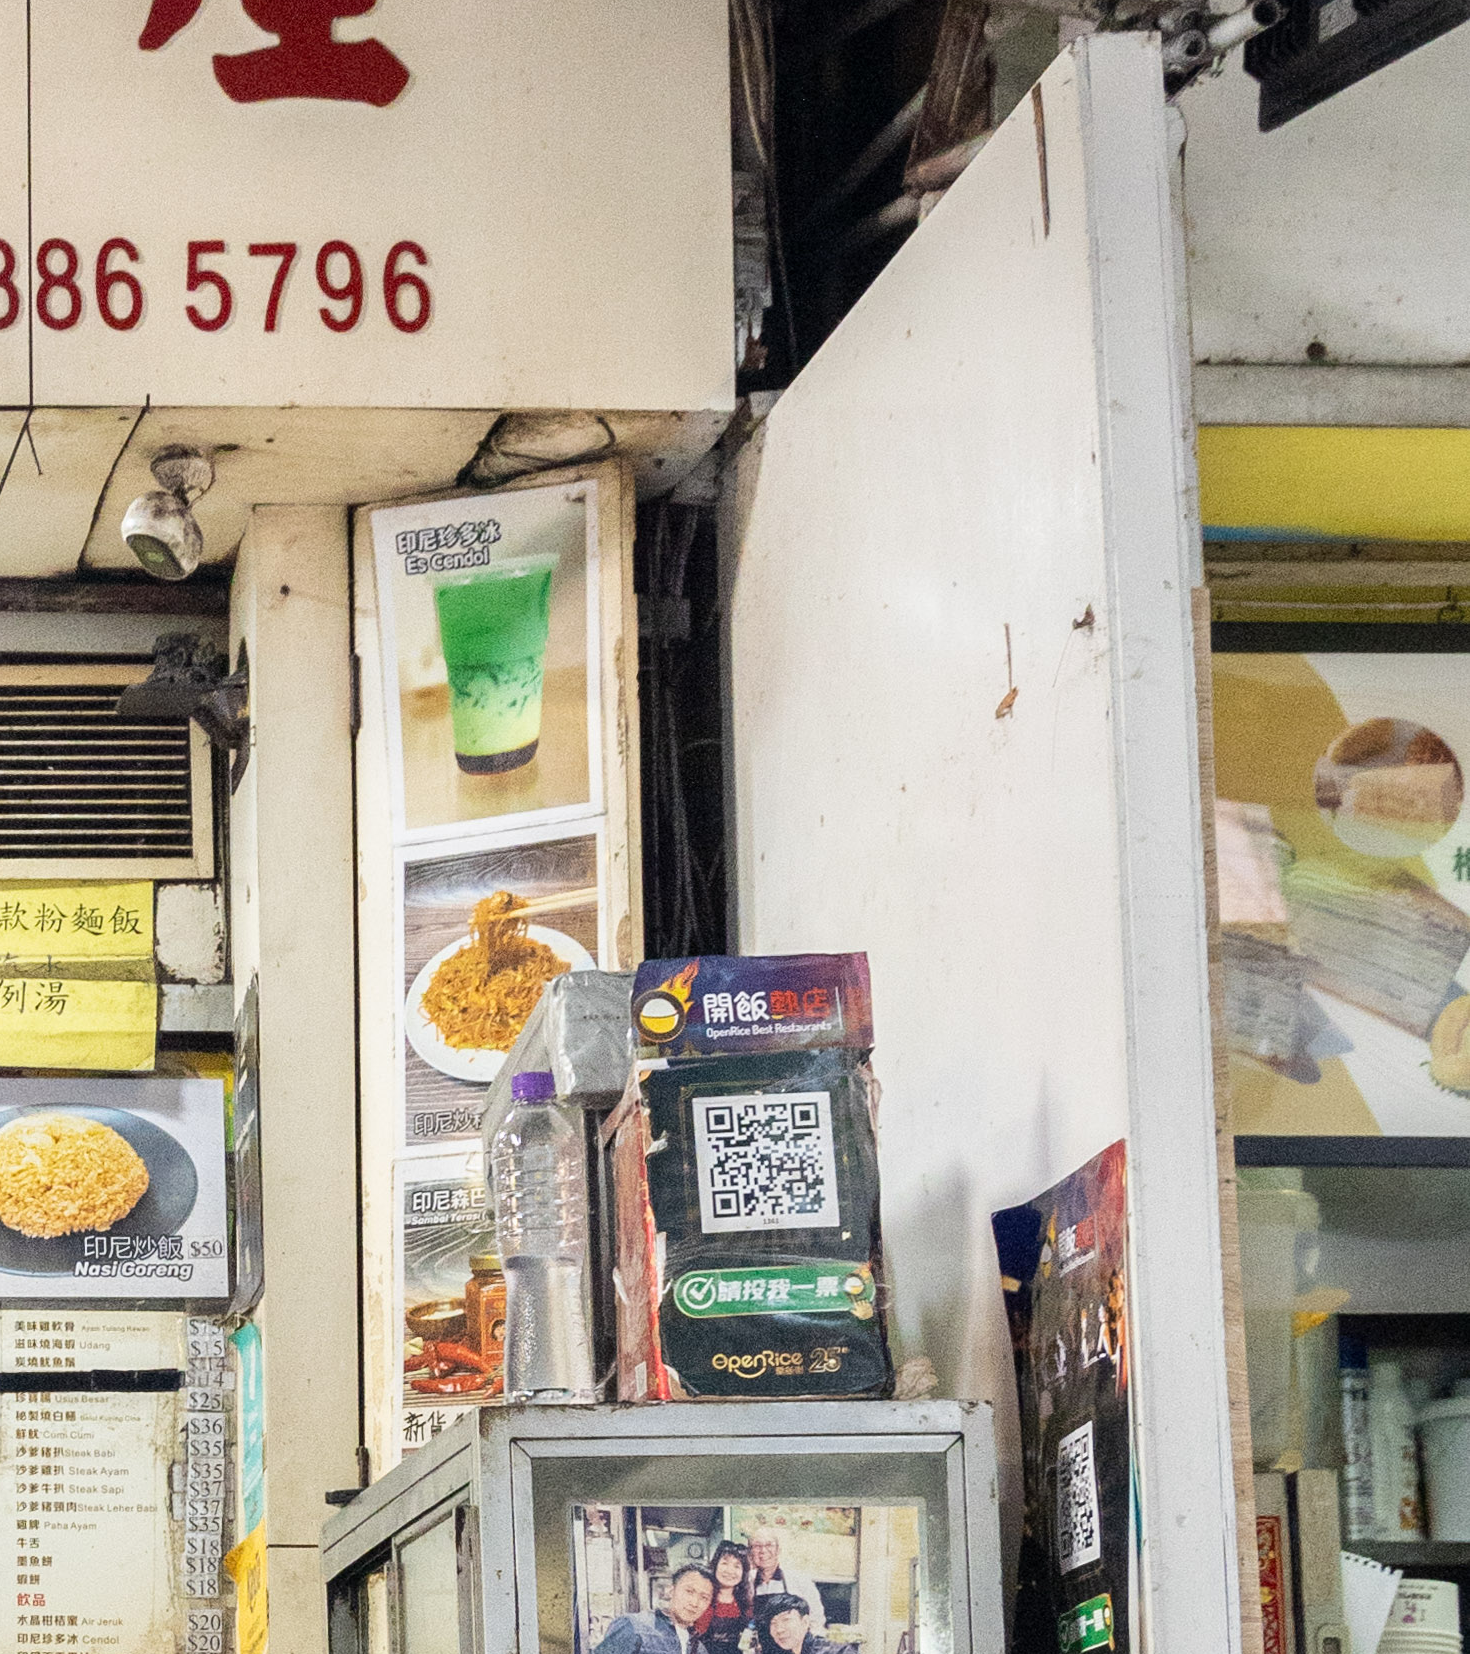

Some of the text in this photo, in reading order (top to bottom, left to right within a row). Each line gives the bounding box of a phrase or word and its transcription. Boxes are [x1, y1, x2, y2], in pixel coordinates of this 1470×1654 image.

[183, 237, 433, 334] 5796
[396, 519, 501, 554] 印尼珍多冰
[405, 545, 490, 575] Es Cendol
[705, 1026, 752, 1039] OpenRice
[752, 1024, 774, 1036] Best
[82, 1234, 183, 1261] 印尼炒飯
[190, 1241, 222, 1258] $50
[73, 1259, 193, 1281] Nasi Goreng
[717, 1276, 840, 1303] 請投我一票
[190, 1417, 223, 1435] $36
[17, 1593, 45, 1607] 飲品
